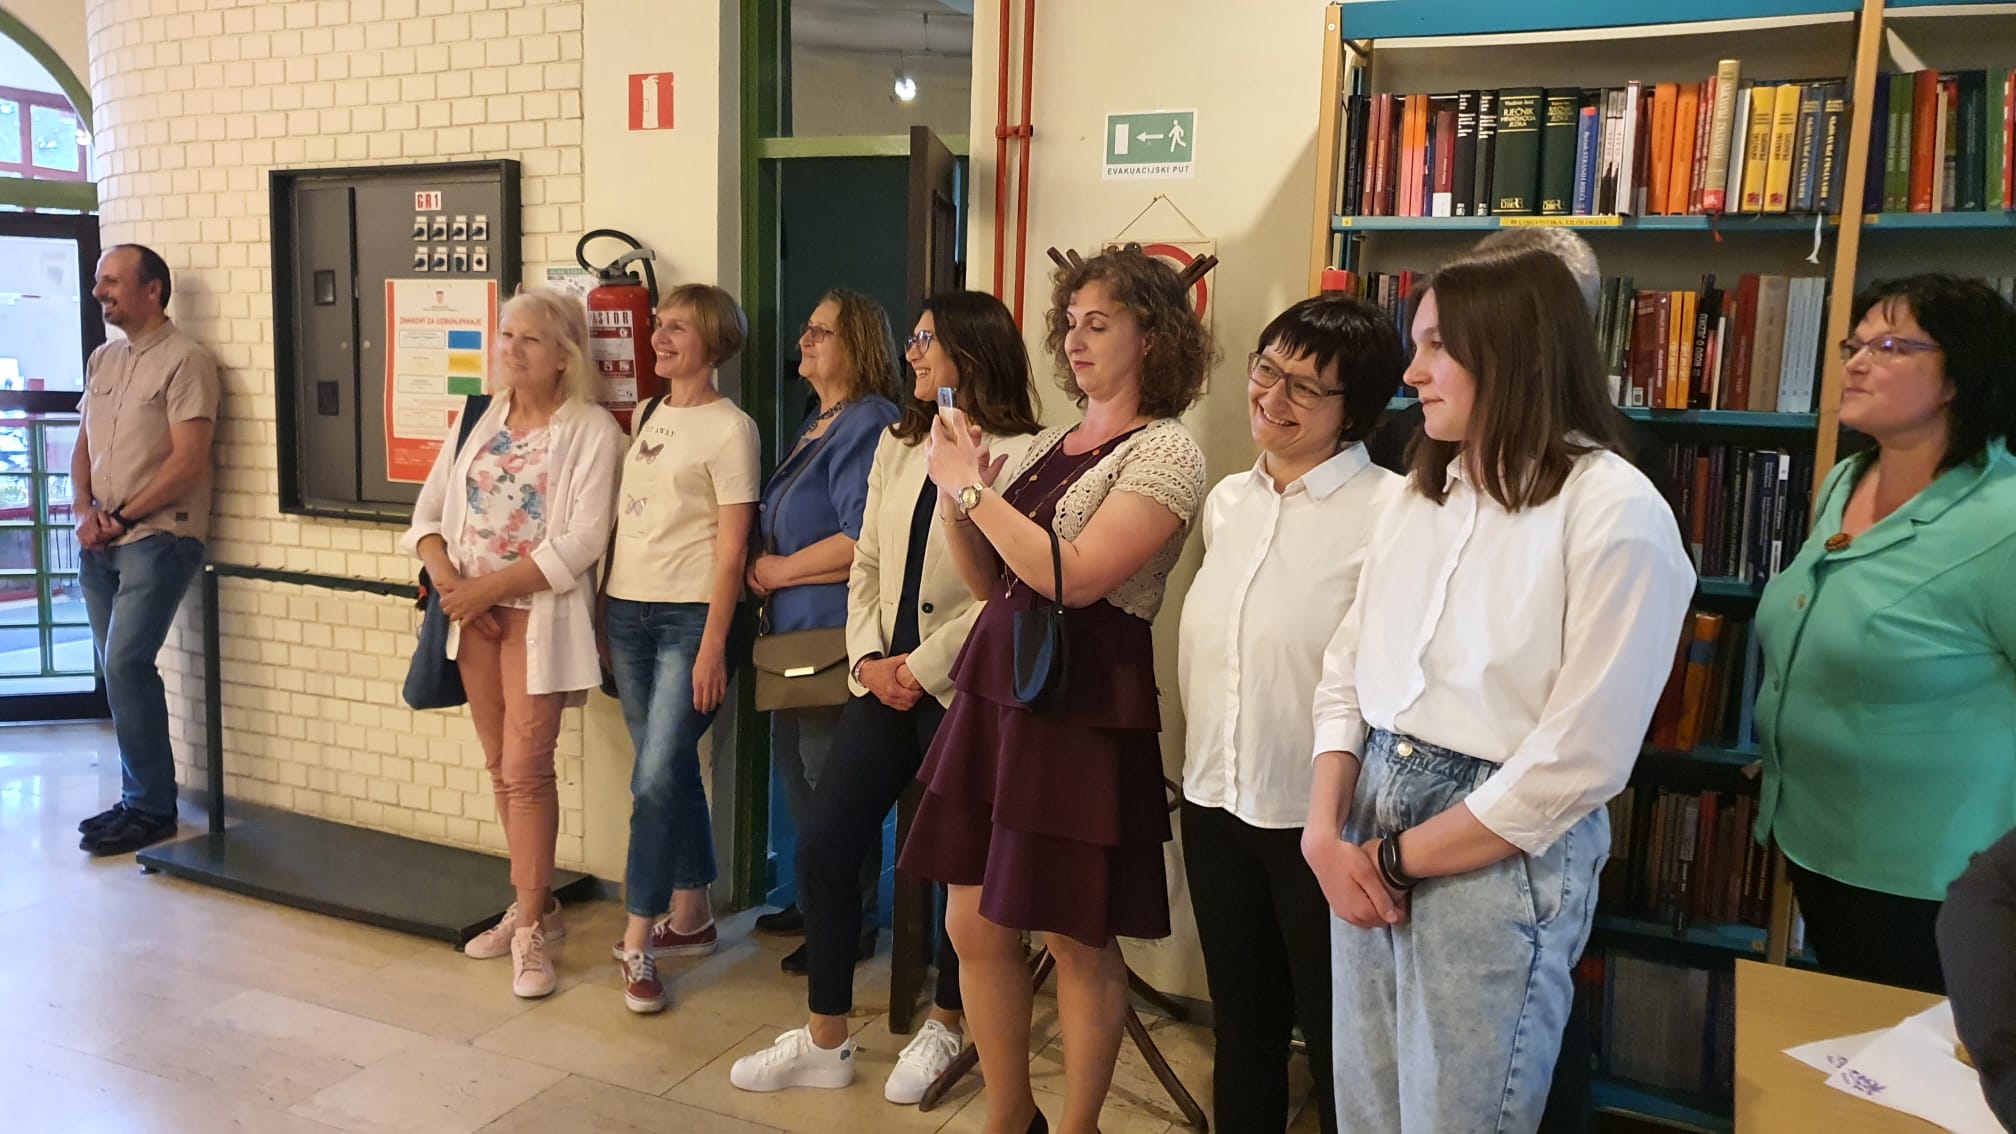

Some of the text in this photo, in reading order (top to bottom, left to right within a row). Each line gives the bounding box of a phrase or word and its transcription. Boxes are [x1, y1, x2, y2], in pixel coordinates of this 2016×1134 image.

[1503, 107, 1534, 116] RJEČNIK
[1712, 122, 1727, 158] HRVATSKI
[1107, 166, 1169, 175] EVAKUACIJSKI
[416, 193, 440, 209] GR1
